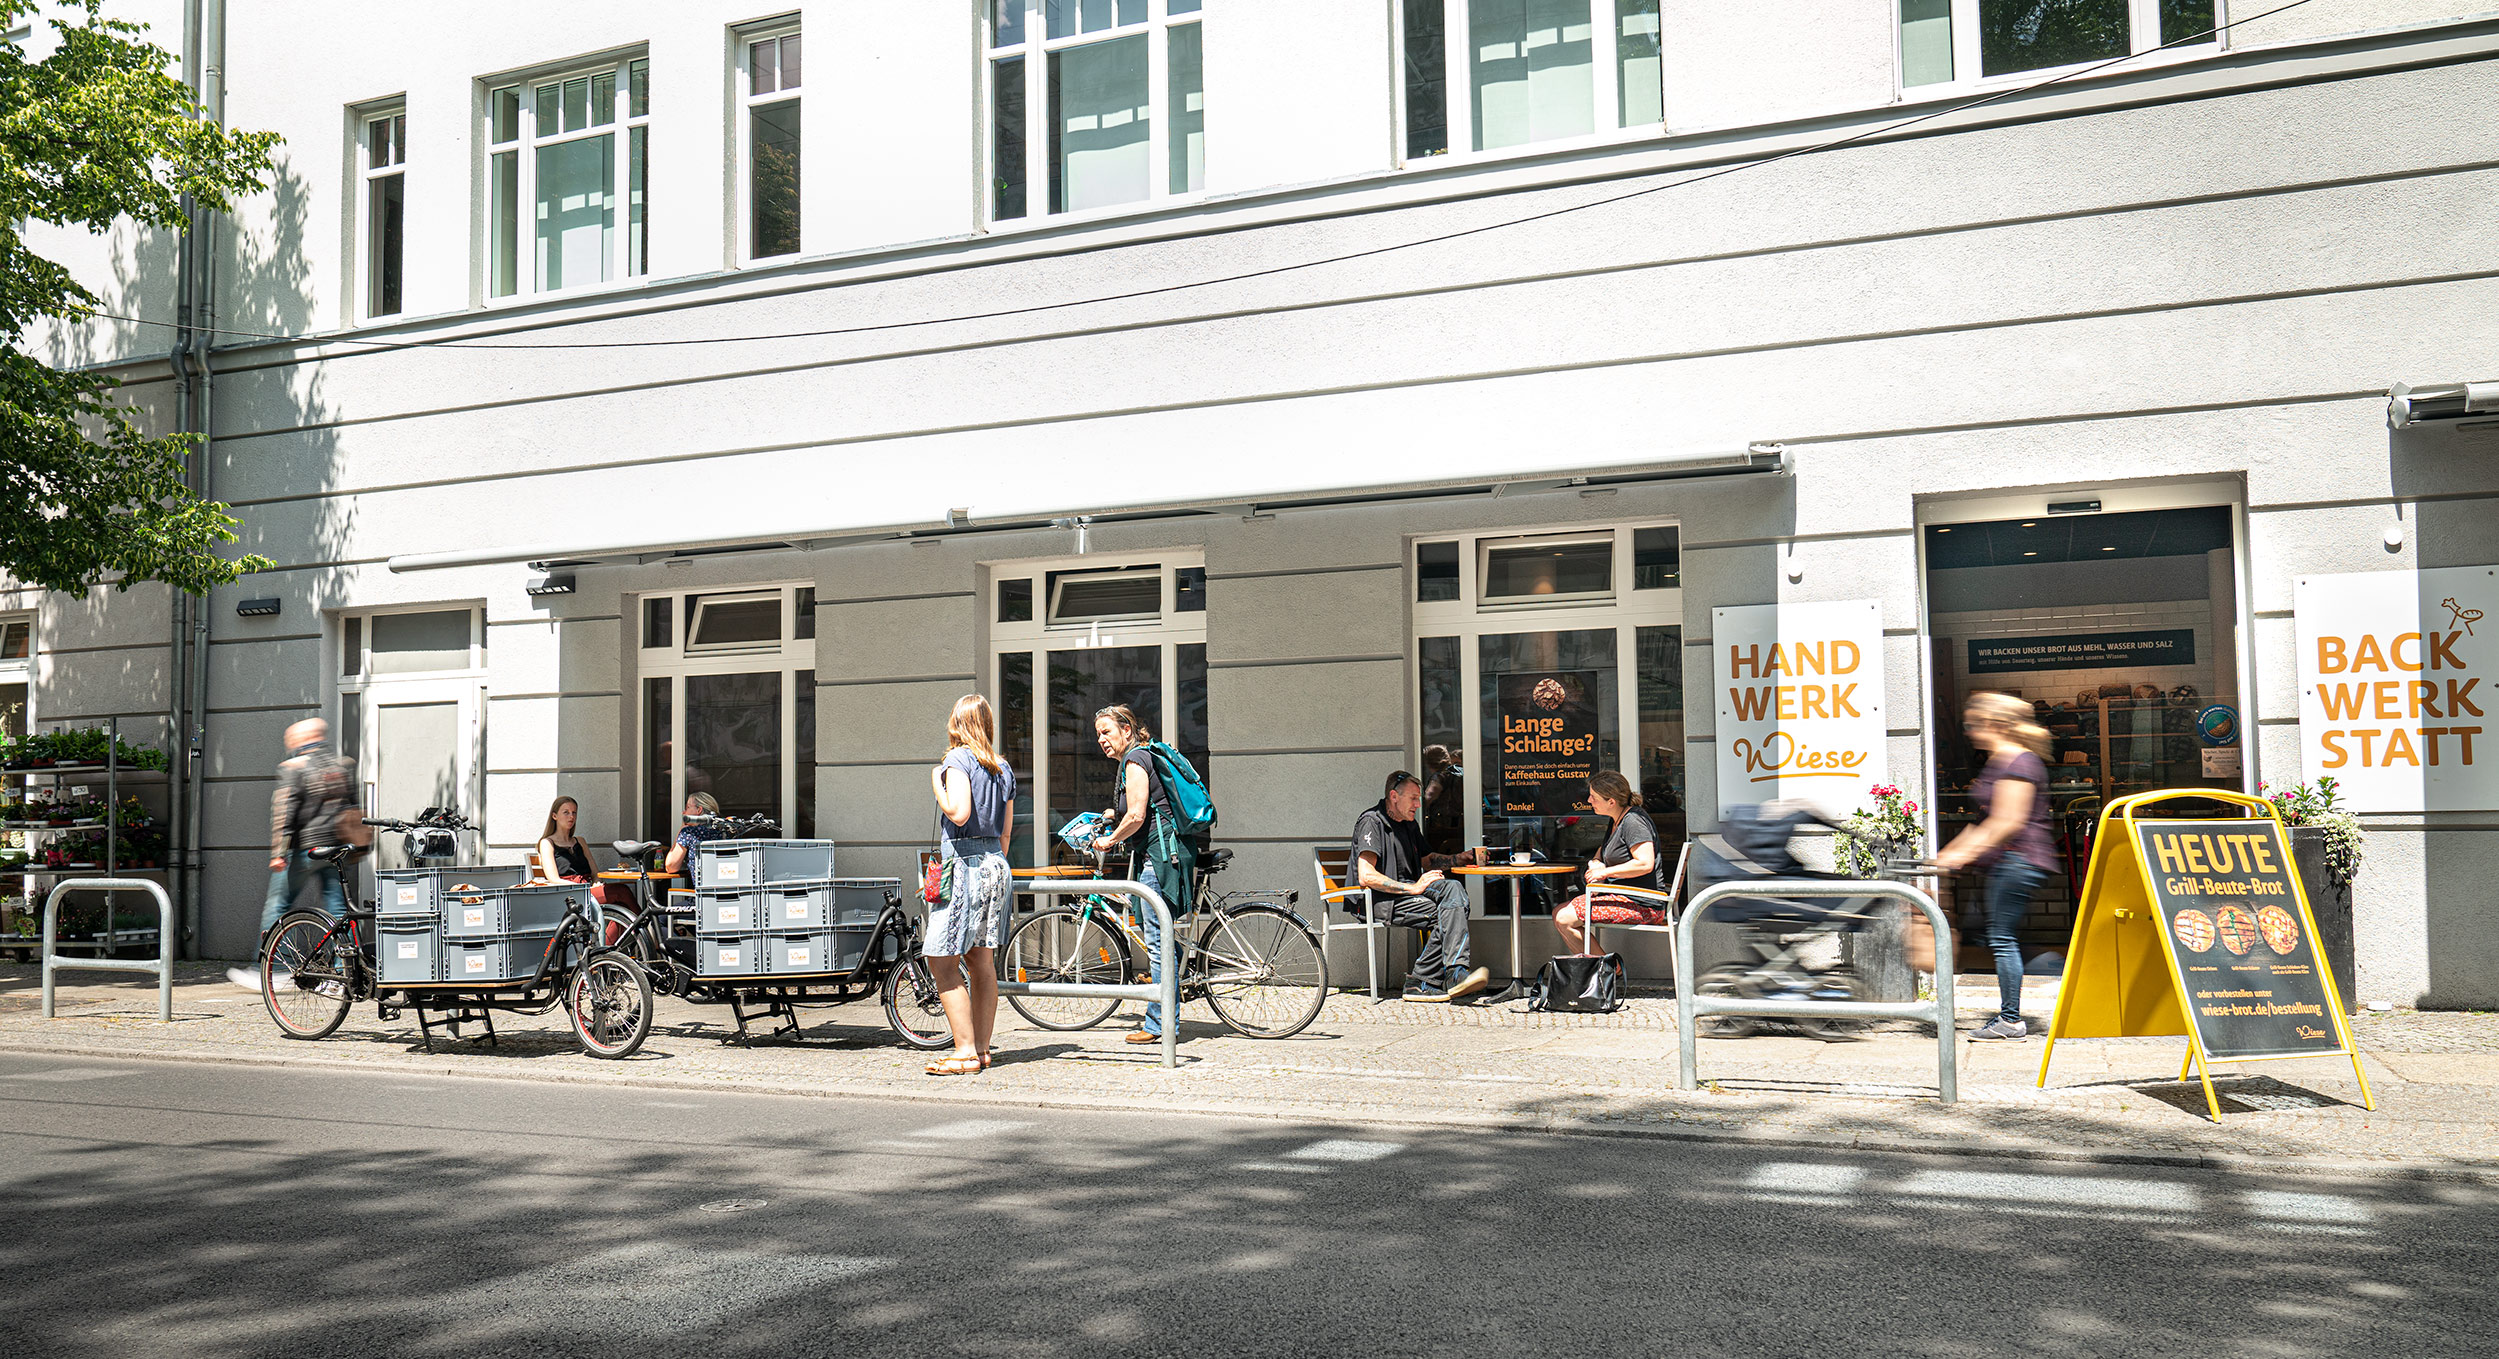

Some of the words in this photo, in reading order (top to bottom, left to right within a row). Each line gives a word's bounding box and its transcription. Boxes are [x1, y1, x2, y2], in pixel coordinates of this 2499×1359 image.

[1731, 640, 1861, 679] HAND
[1993, 648, 2021, 656] BACKEN
[2022, 646, 2046, 654] UNSER
[2047, 645, 2066, 653] BROT
[2083, 644, 2106, 652] MEHL,
[2107, 642, 2136, 650] WASSER
[2137, 641, 2154, 649] UND
[2155, 640, 2173, 648] SALZ
[2317, 630, 2467, 674] BACK
[1729, 683, 1861, 721] WERK
[2316, 678, 2484, 721] WERK
[1504, 714, 1564, 737] Lange
[1504, 733, 1594, 756] Schlange?
[1733, 731, 1868, 775] Wiese
[2321, 726, 2482, 769] STATT
[1504, 770, 1555, 780] Kaffeehaus
[1557, 769, 1590, 779] Gustav
[1506, 802, 1535, 811] Danke!
[2153, 834, 2278, 874] HEUTE
[2165, 876, 2286, 896] Grill-Beute-Brot
[2196, 990, 2213, 999] oder
[2213, 989, 2254, 998] vorbestellen
[2254, 990, 2272, 998] unter
[2200, 1001, 2323, 1017] wiese-brot.de/bestellung
[2296, 1025, 2326, 1037] Wiese
